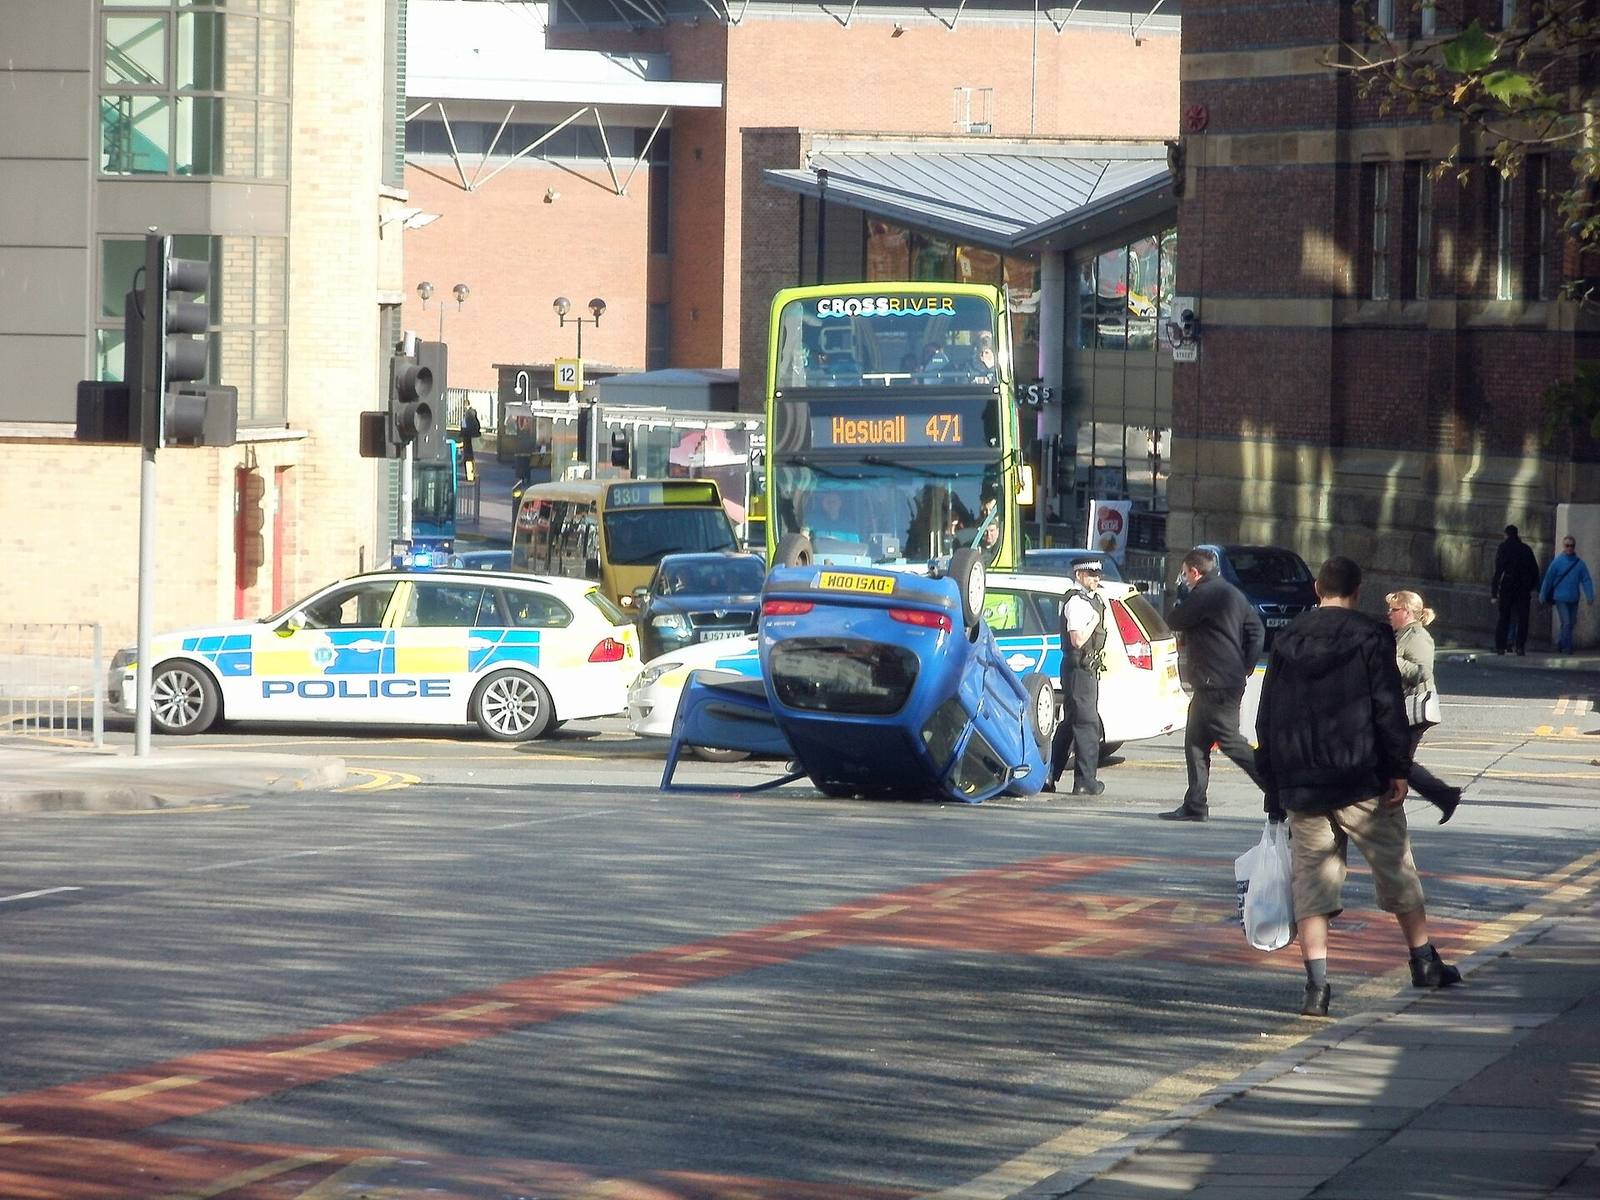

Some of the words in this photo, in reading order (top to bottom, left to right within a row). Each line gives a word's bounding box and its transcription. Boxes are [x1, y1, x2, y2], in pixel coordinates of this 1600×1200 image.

[560, 367, 574, 382] 12
[832, 415, 905, 444] Heswall
[925, 414, 961, 442] 471
[262, 679, 451, 699] POLICE
